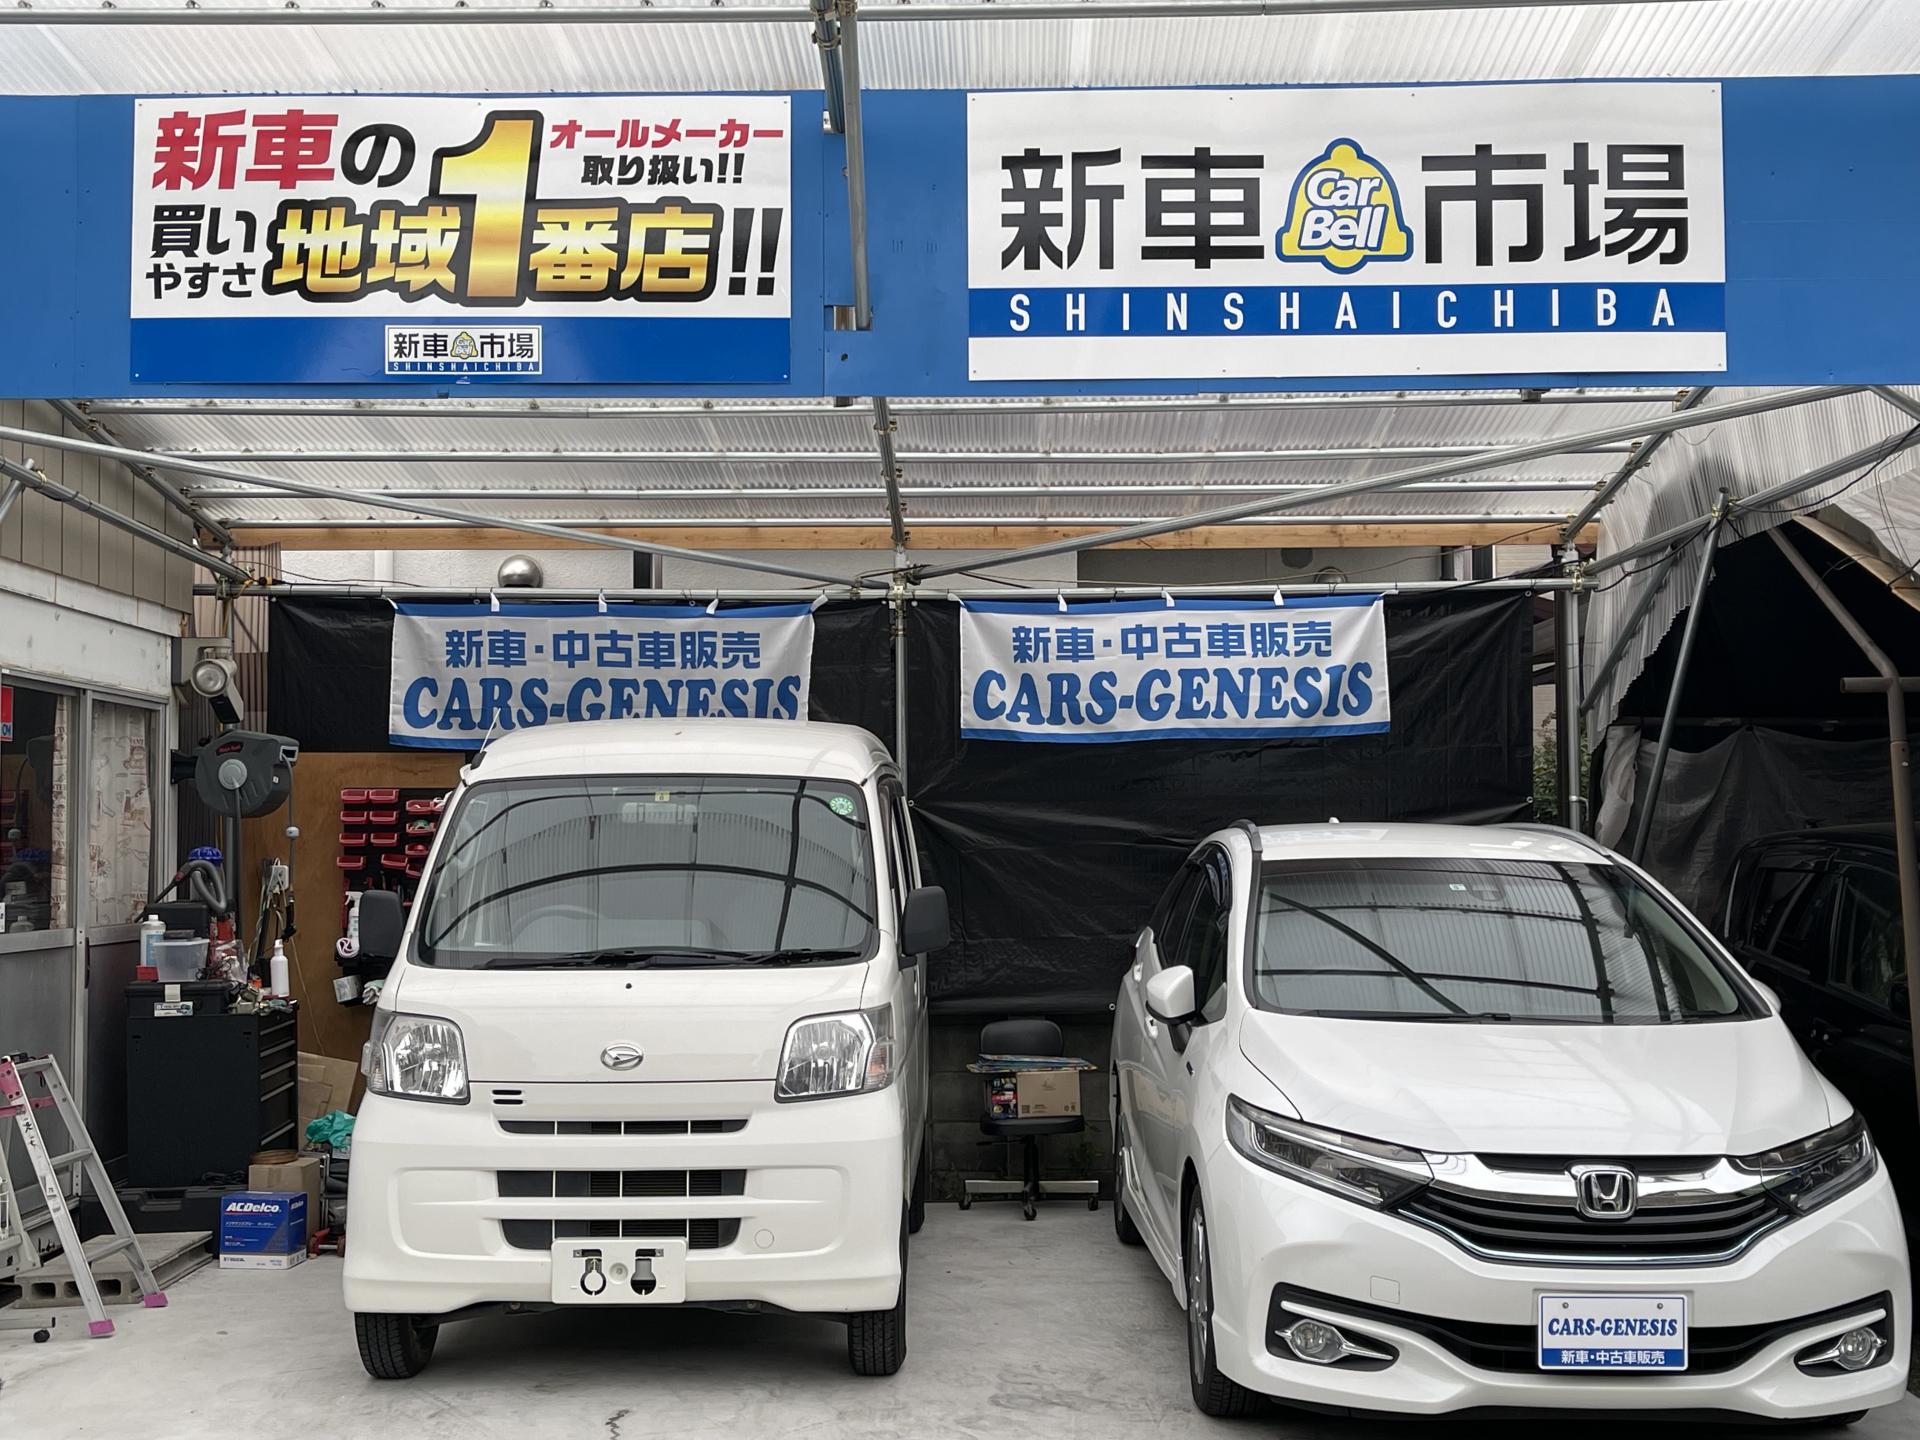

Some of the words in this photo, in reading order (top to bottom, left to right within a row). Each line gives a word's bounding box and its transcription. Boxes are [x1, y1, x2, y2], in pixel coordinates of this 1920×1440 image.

[152, 109, 416, 191] 新車の
[551, 118, 784, 150] オールメーカー
[581, 152, 745, 186] 取り扱い!!
[1305, 168, 1382, 207] Car
[1000, 146, 1265, 271] 新車
[1420, 142, 1690, 267] 市場
[150, 204, 256, 259] 買い
[1298, 205, 1389, 251] Bell
[145, 261, 256, 300] やすさ
[1008, 287, 1677, 333] SHINSHAICHIBA
[393, 332, 449, 359] 新車
[479, 332, 535, 359] 市場
[393, 362, 535, 371] SHINSHAICHIBA
[445, 629, 761, 670] 新車・中古車販売
[1011, 620, 1333, 664] 新車・中古車販売
[402, 674, 802, 731] CARS-GENESIS
[972, 661, 1374, 727] CARS-GENESIS
[226, 1202, 280, 1213] ACDelco
[1548, 1318, 1678, 1336] CARS-GENESIS
